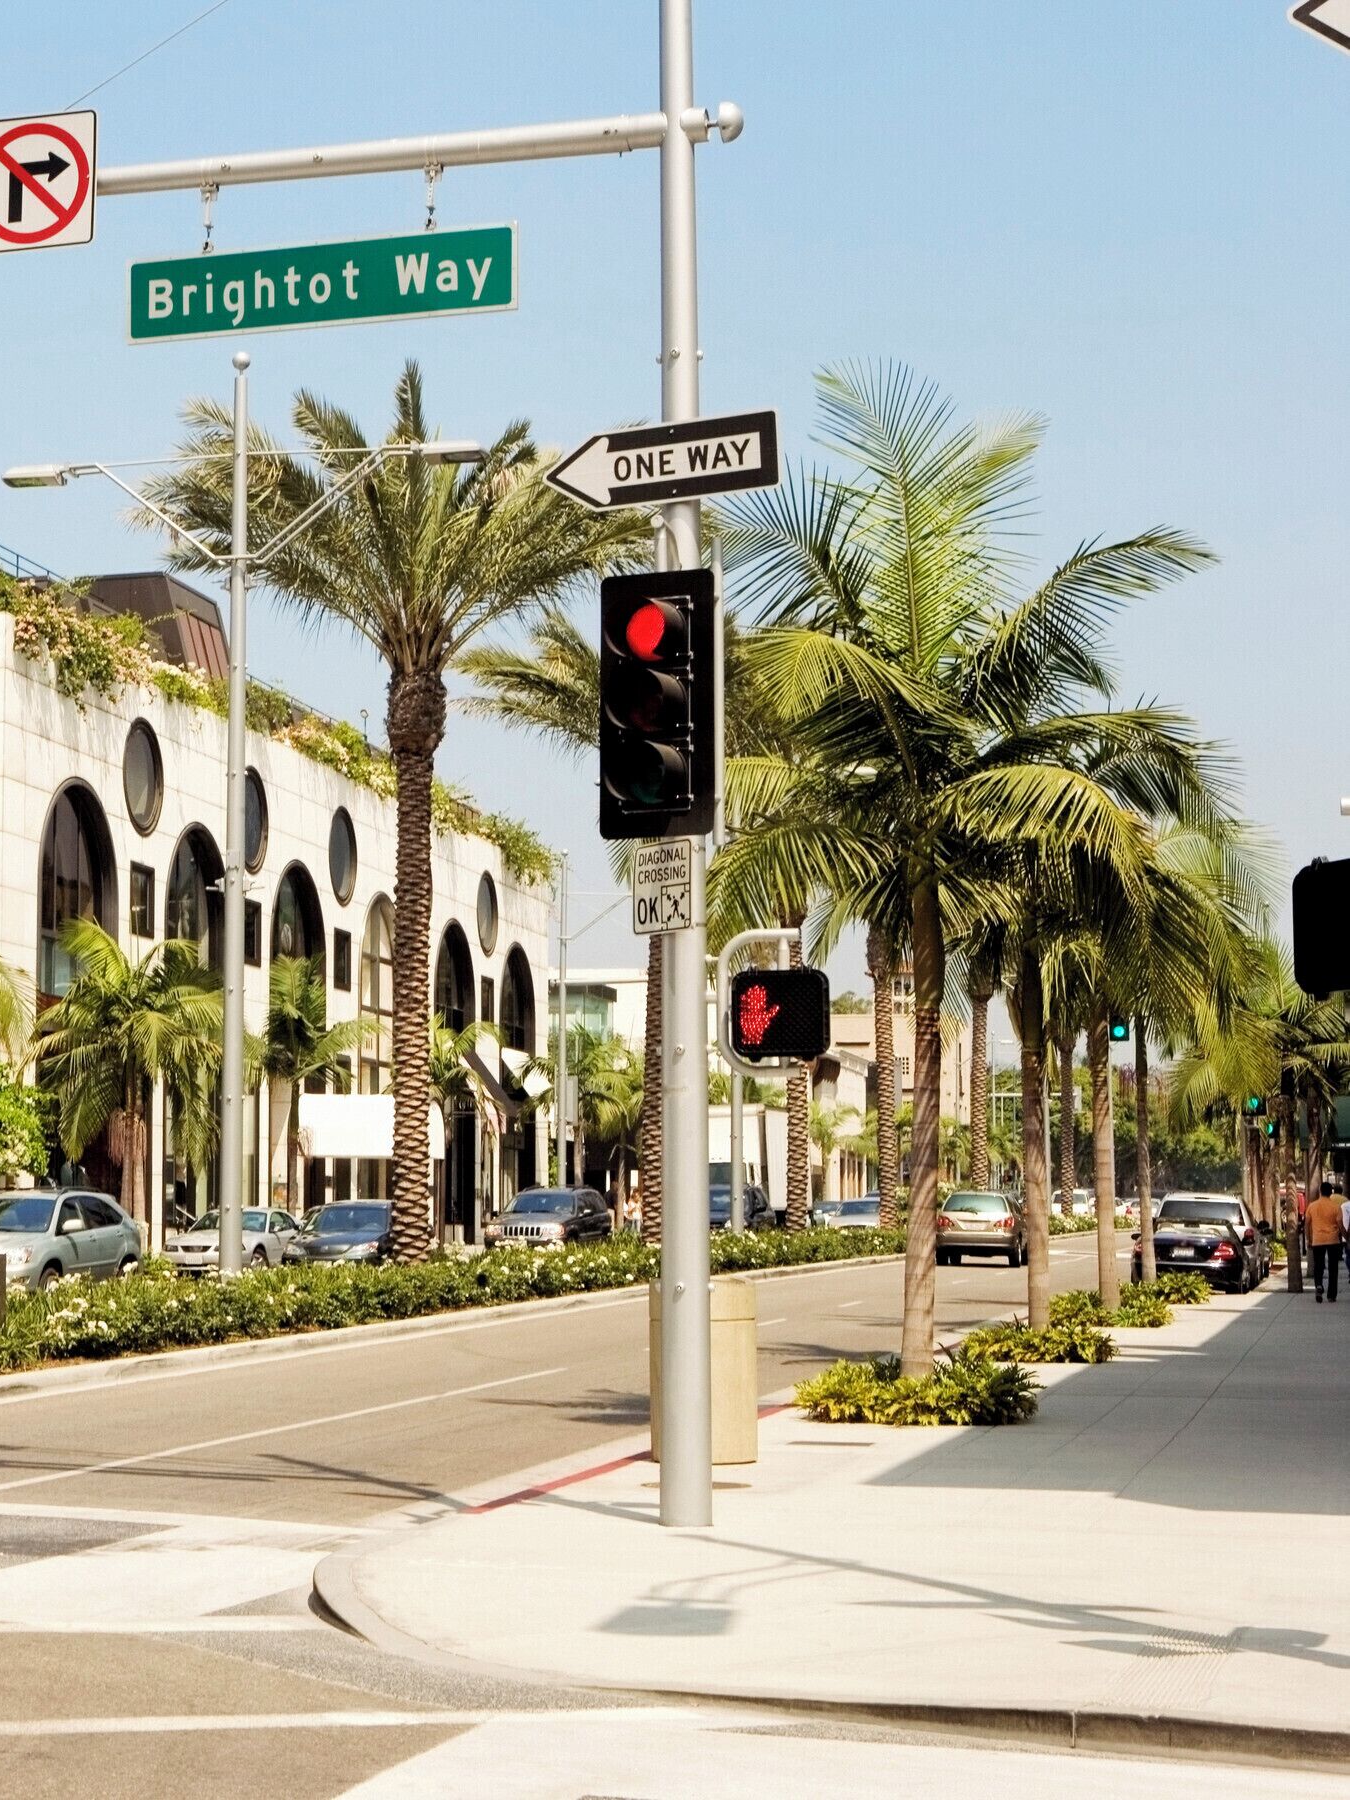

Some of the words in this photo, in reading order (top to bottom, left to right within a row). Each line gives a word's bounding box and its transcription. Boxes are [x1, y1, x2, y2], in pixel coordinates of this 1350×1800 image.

[148, 259, 360, 327] Brightot
[394, 252, 493, 300] Way
[613, 449, 676, 482] ONE
[686, 438, 751, 472] WAY
[638, 847, 687, 867] DIAGONAL
[637, 864, 686, 885] CROSSING
[637, 896, 659, 925] OK
